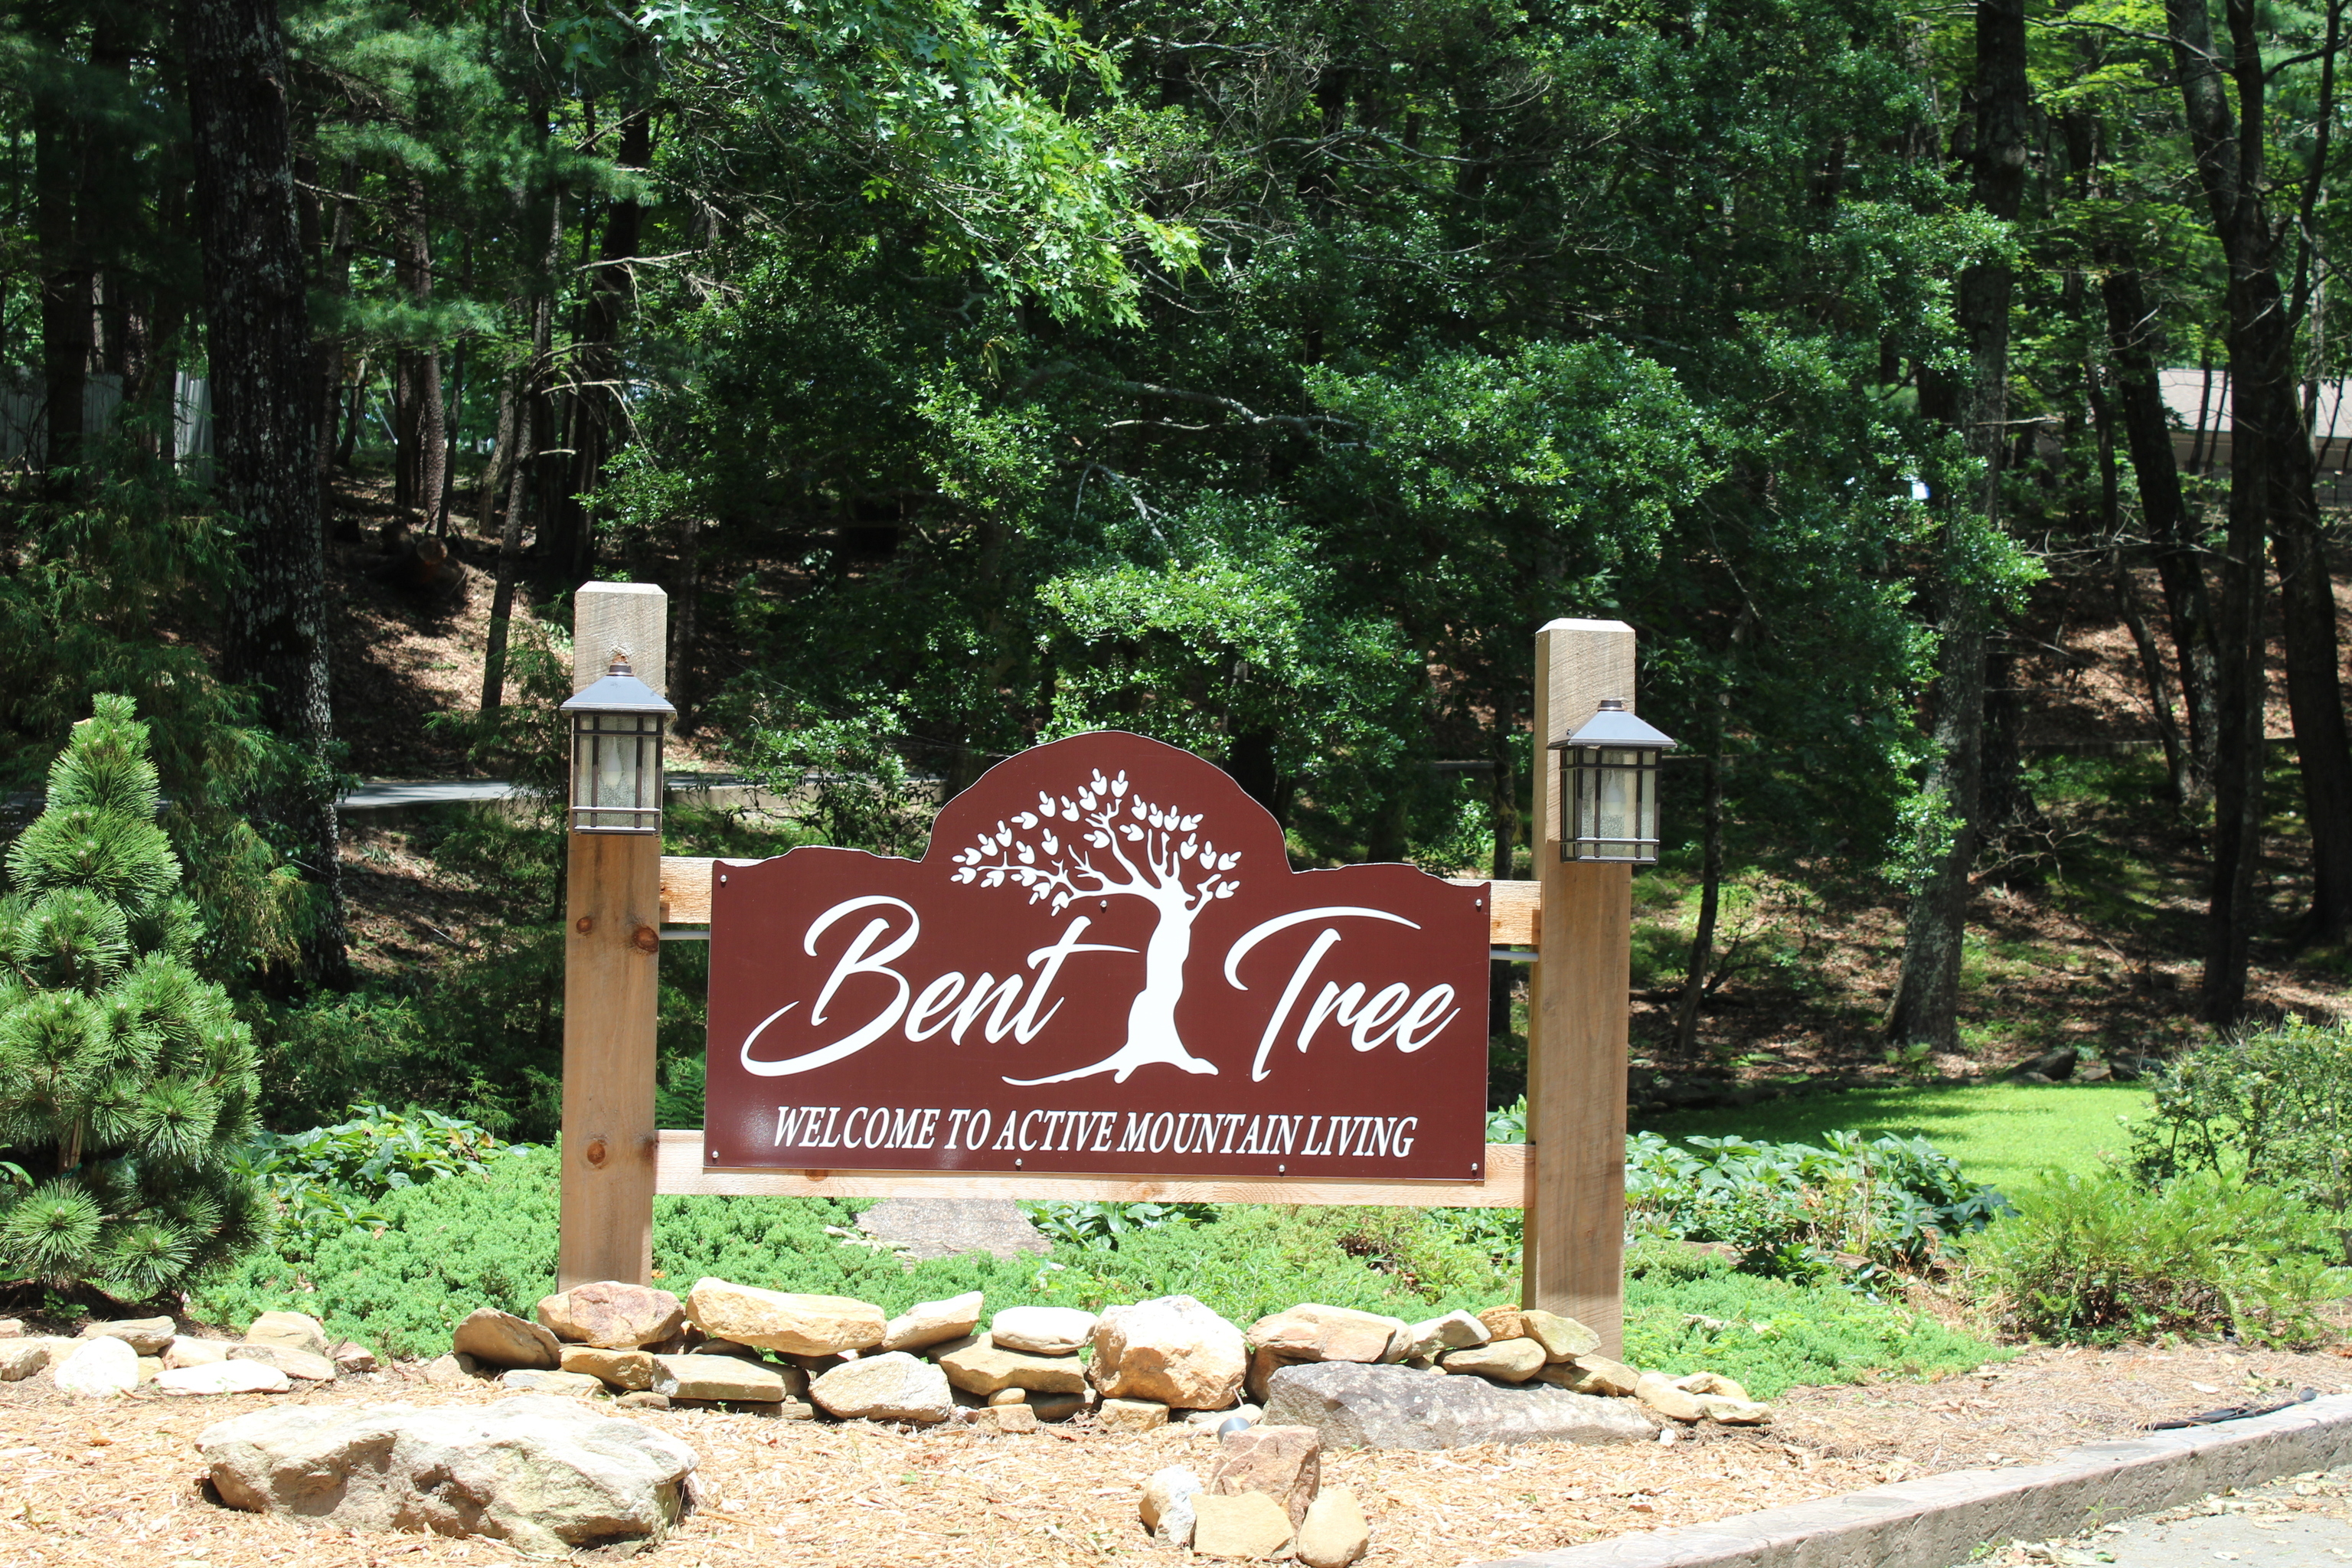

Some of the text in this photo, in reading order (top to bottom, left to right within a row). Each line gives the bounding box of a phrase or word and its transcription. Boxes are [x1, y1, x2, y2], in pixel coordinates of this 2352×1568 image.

[740, 894, 1461, 1083] Bent Tree
[773, 1105, 1419, 1158] WELCOME TO ACTIVE MOUNTAIN LIVING
